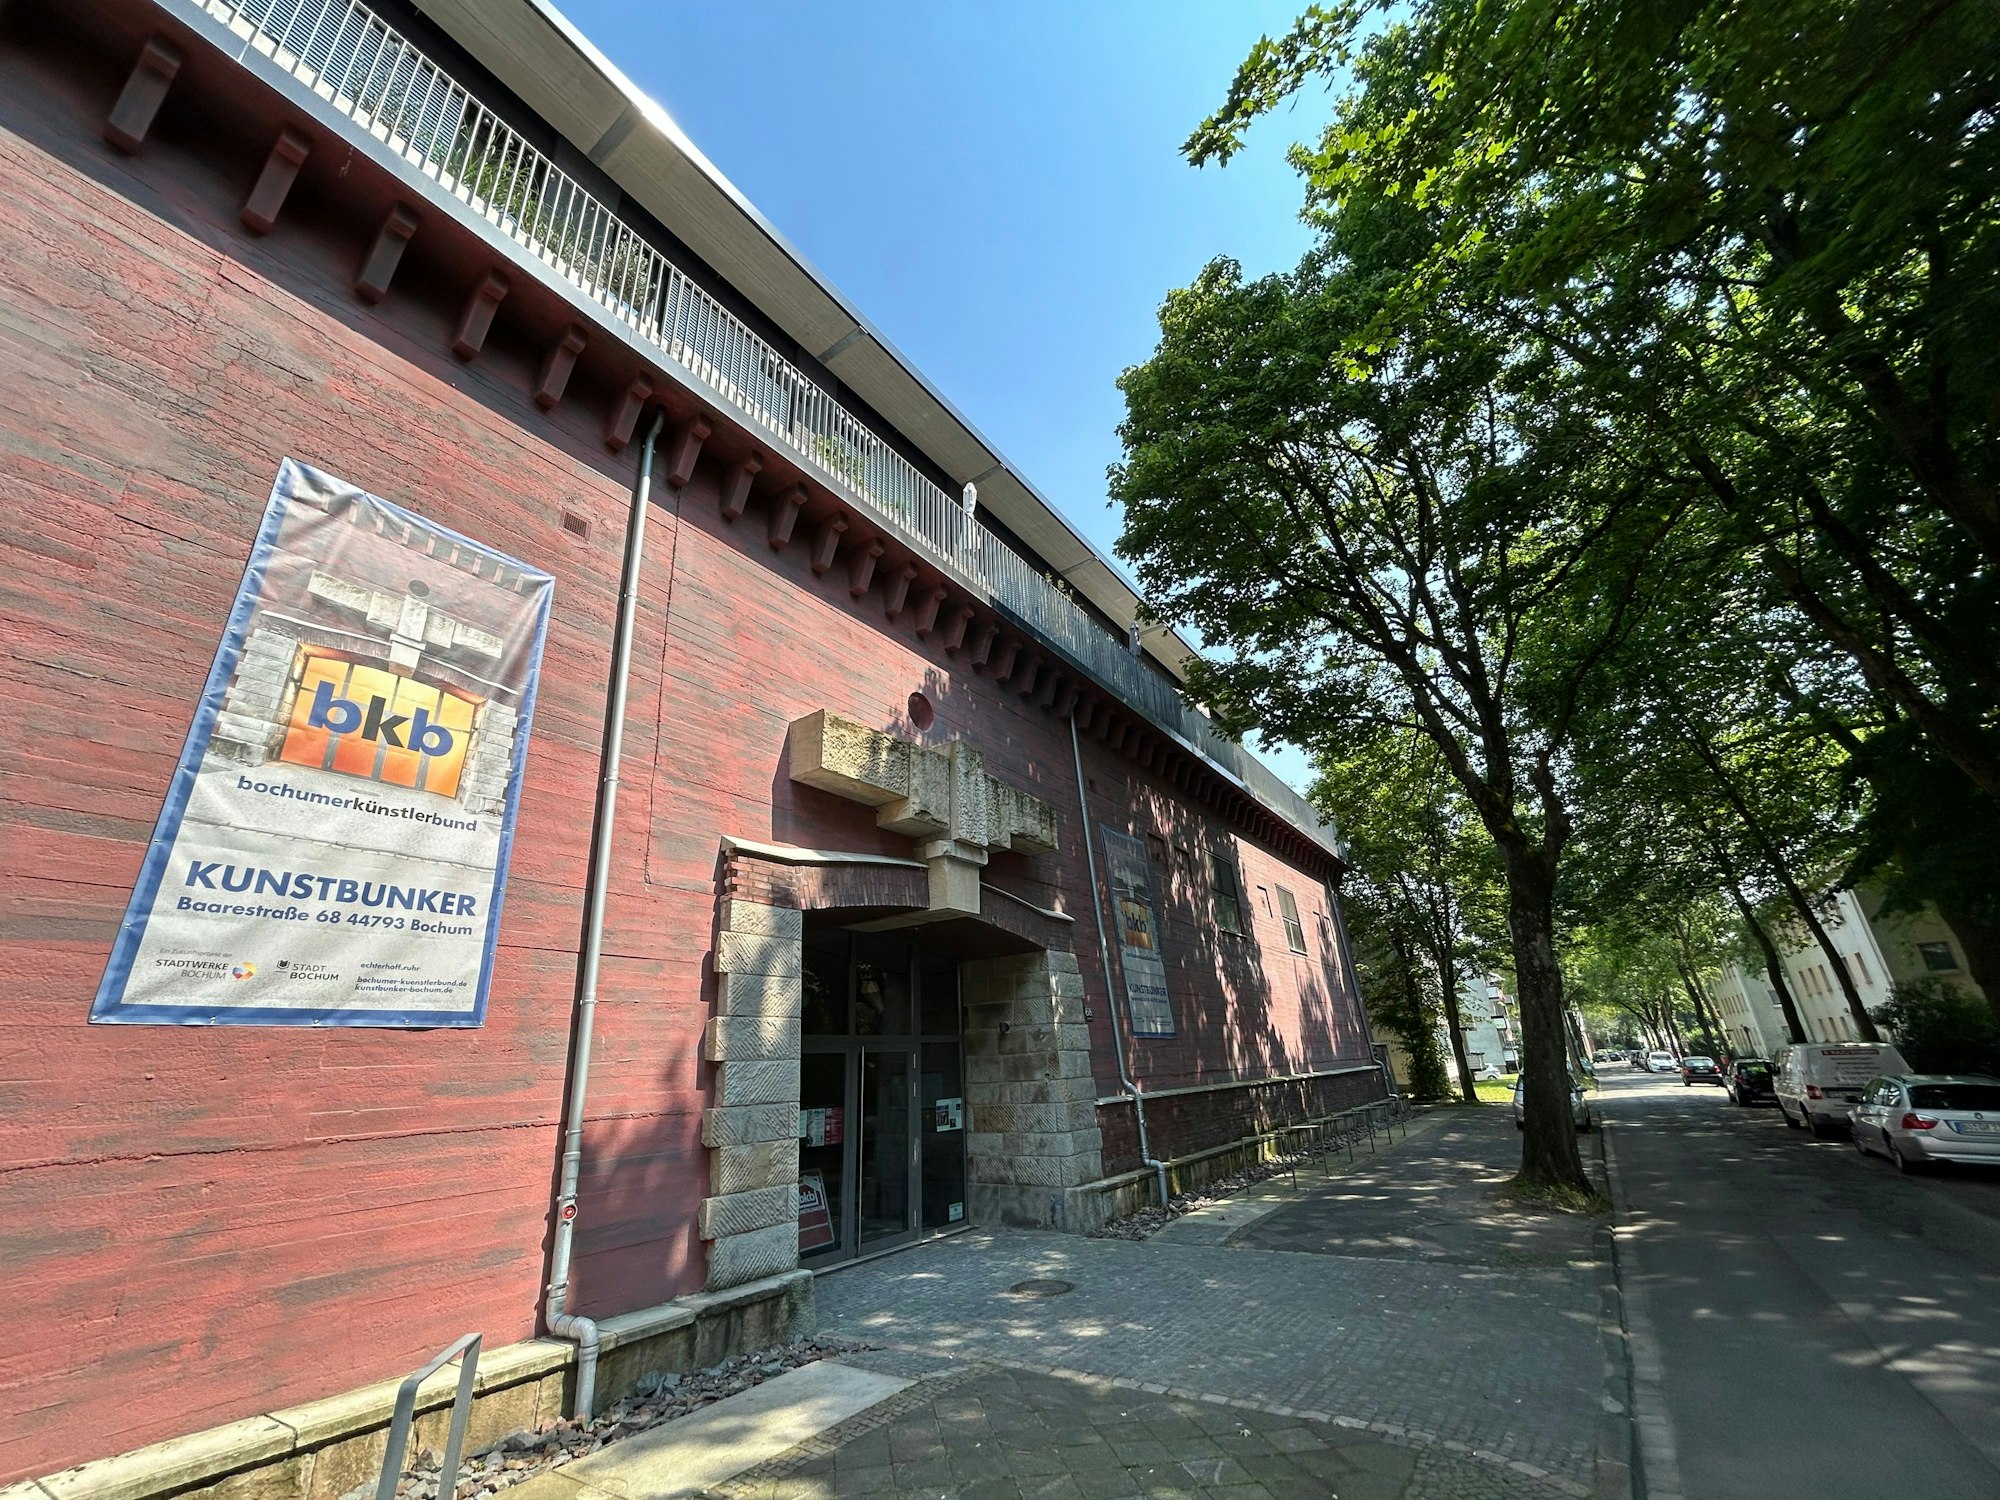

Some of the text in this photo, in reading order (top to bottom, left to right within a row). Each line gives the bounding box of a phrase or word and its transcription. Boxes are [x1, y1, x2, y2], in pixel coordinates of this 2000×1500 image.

[307, 680, 454, 757] bkb
[237, 776, 477, 832] bochumerkünstlerbund
[185, 860, 477, 917] KUNSTBUNKER
[176, 896, 472, 936] Baarestraße 68 44793 Bochum
[155, 959, 229, 971] STADTWERKE
[292, 963, 327, 972] STADT
[360, 962, 421, 972] echterhoff.ruhr
[180, 969, 227, 979] BOCHUM
[290, 972, 340, 981] BOCHUM
[357, 976, 467, 987] bochumer-kuenstlerbund.de
[354, 984, 453, 994] kunstbunker-bochum.de
